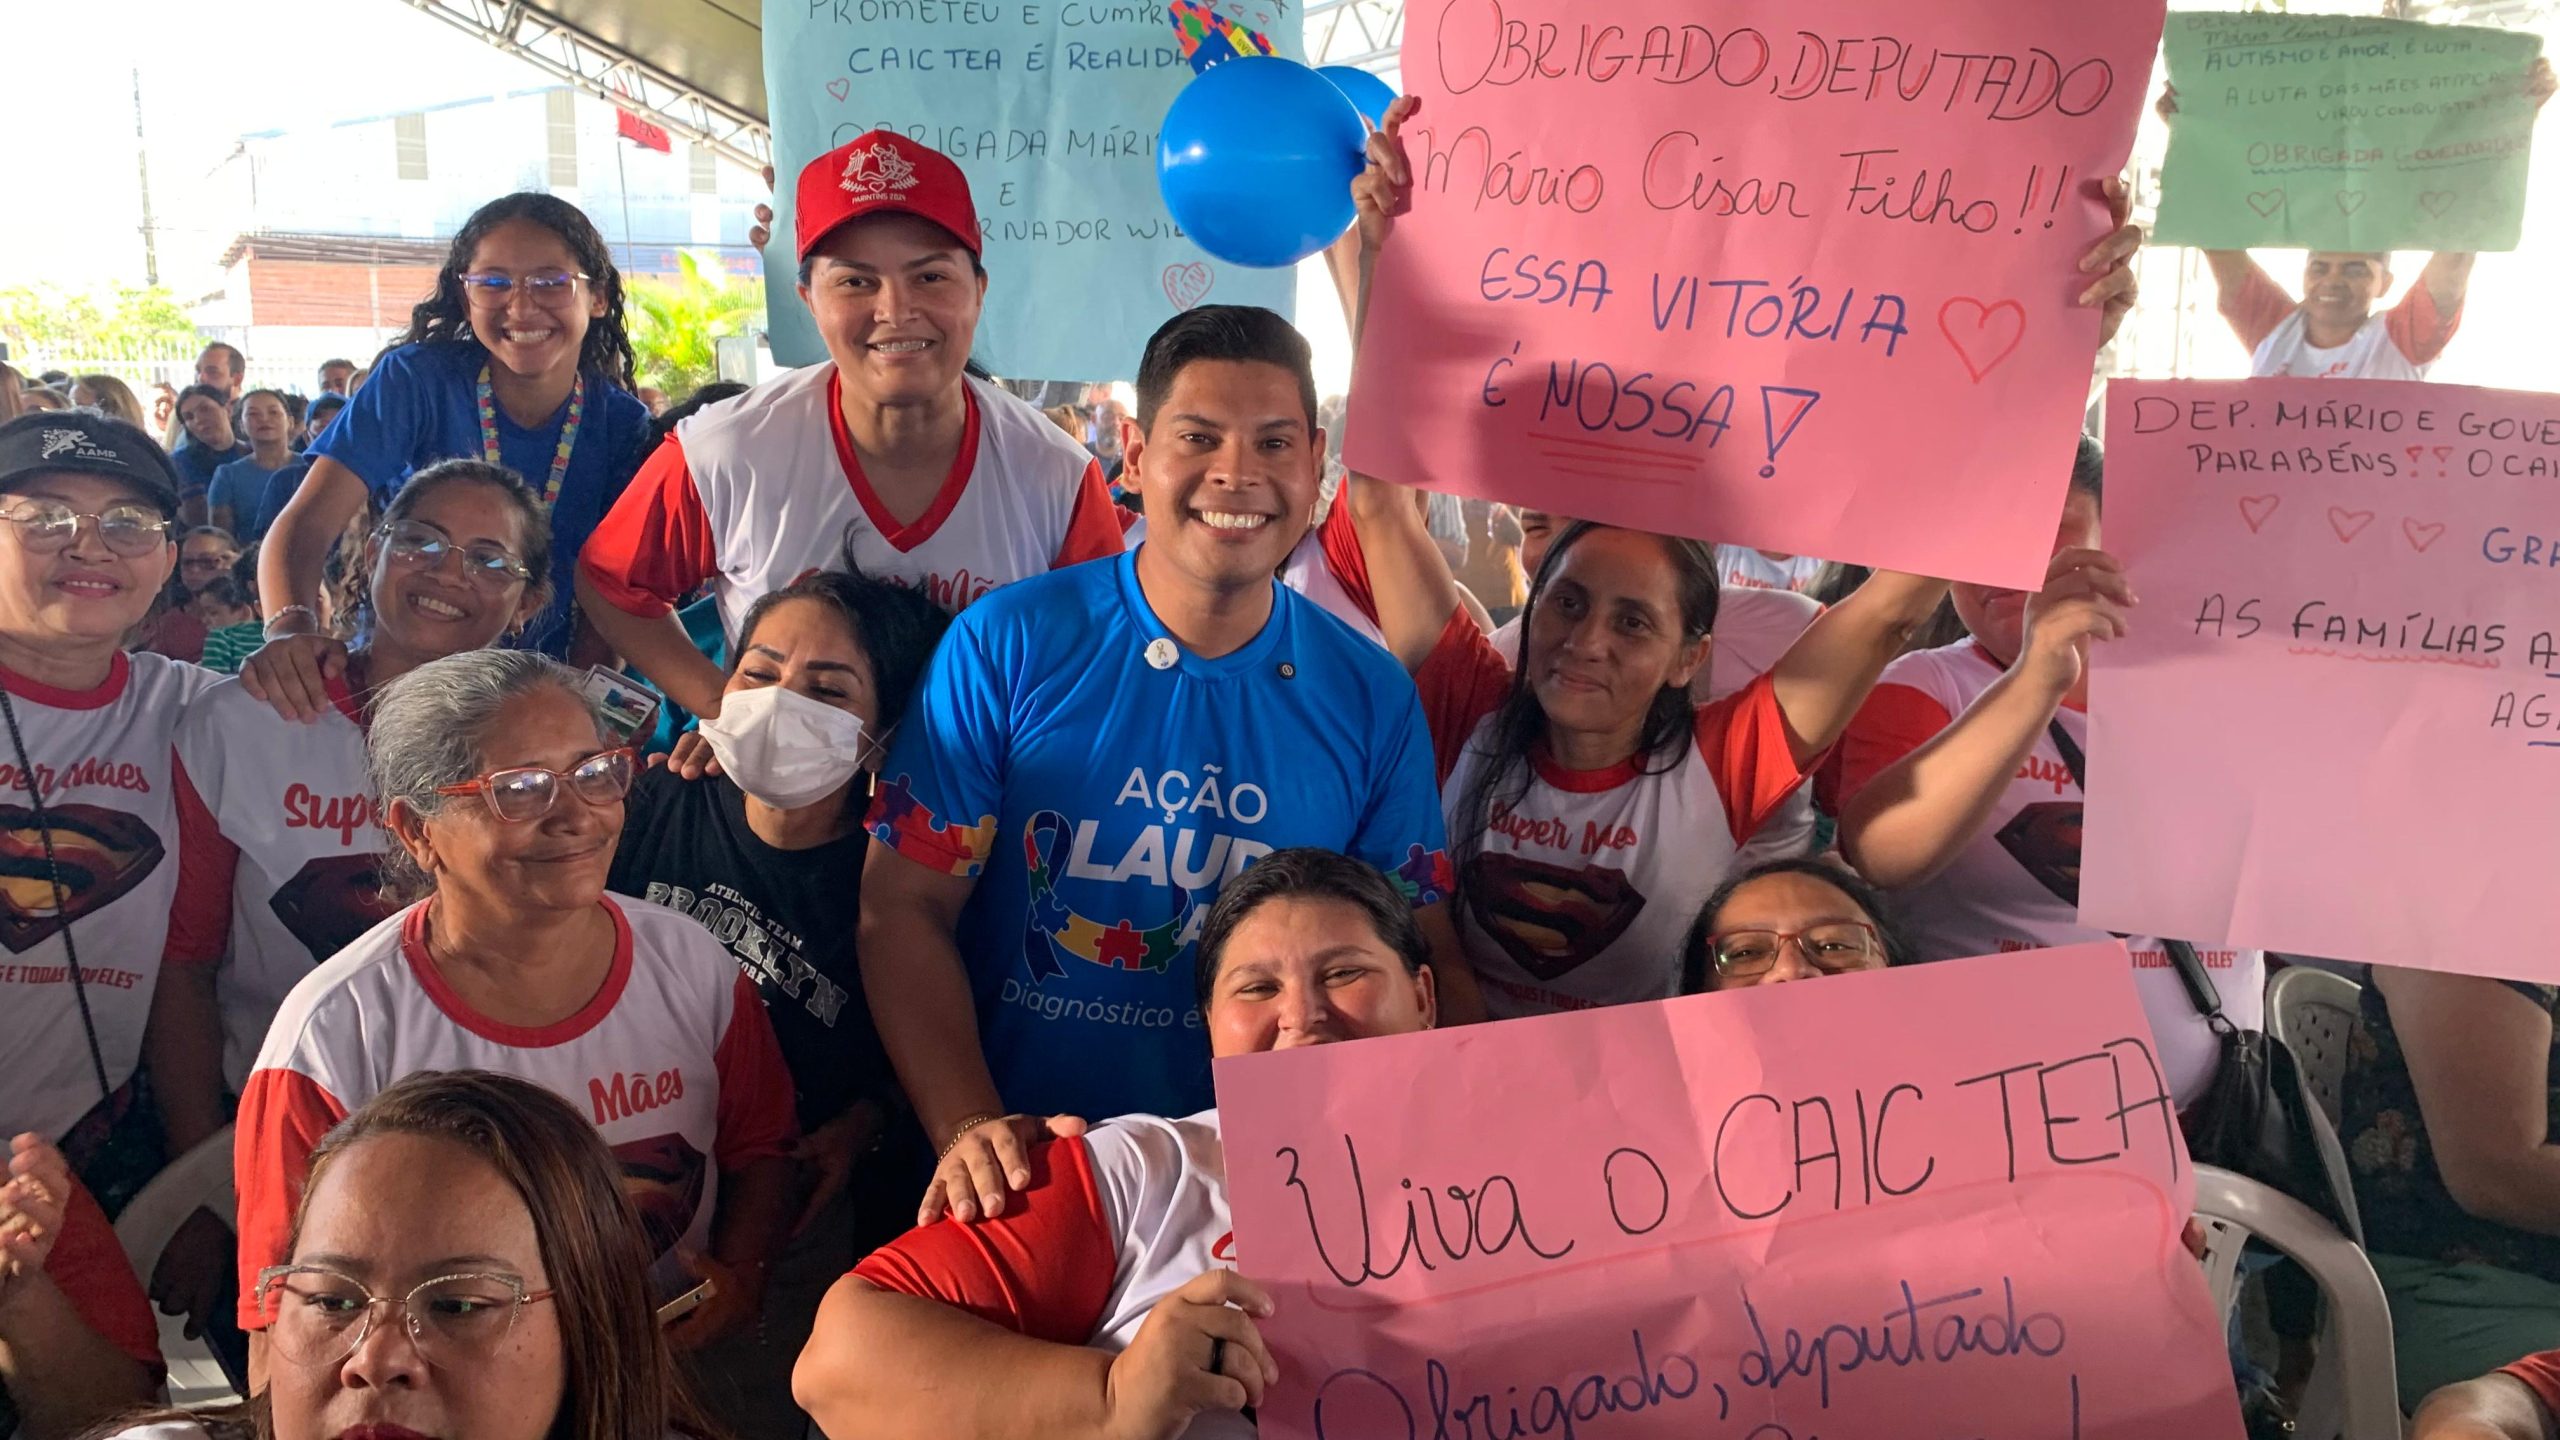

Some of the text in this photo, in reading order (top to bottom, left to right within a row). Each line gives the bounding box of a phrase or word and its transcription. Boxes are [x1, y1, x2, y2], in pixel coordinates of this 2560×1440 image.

[1022, 1, 1041, 26] E
[1061, 0, 1166, 27] CUMPR
[848, 46, 934, 75] CAIC
[943, 48, 1001, 72] TEA
[1025, 42, 1046, 72] É
[1068, 41, 1190, 71] REALIDA
[1776, 31, 2115, 120] DEPUTADO
[2205, 48, 2314, 72] AUTISMO
[831, 121, 1161, 160] ORIGADA MÁRI
[1000, 181, 1017, 207] E
[1416, 124, 1604, 214] Mário
[981, 217, 1186, 246] RNADOR WIL
[1479, 247, 1909, 358] ESSA VITÓRIA
[1481, 340, 1523, 408] É
[2133, 396, 2560, 447] DEP. MÁRIO E GOVE
[2503, 453, 2559, 478] CAI
[2194, 592, 2261, 639] AS
[2292, 601, 2507, 654] FAMÍLIAS
[2490, 690, 2560, 731] AG
[1114, 763, 1269, 825] AÇÃO
[644, 880, 850, 1029] BROOKLYN
[766, 918, 804, 951] TEAM
[1000, 977, 1175, 1029] Diagnóstico
[587, 1066, 684, 1126] Mães
[1714, 1083, 1935, 1220] CAIC
[1954, 1036, 2180, 1184] TEA
[1737, 1276, 2067, 1409] deputado
